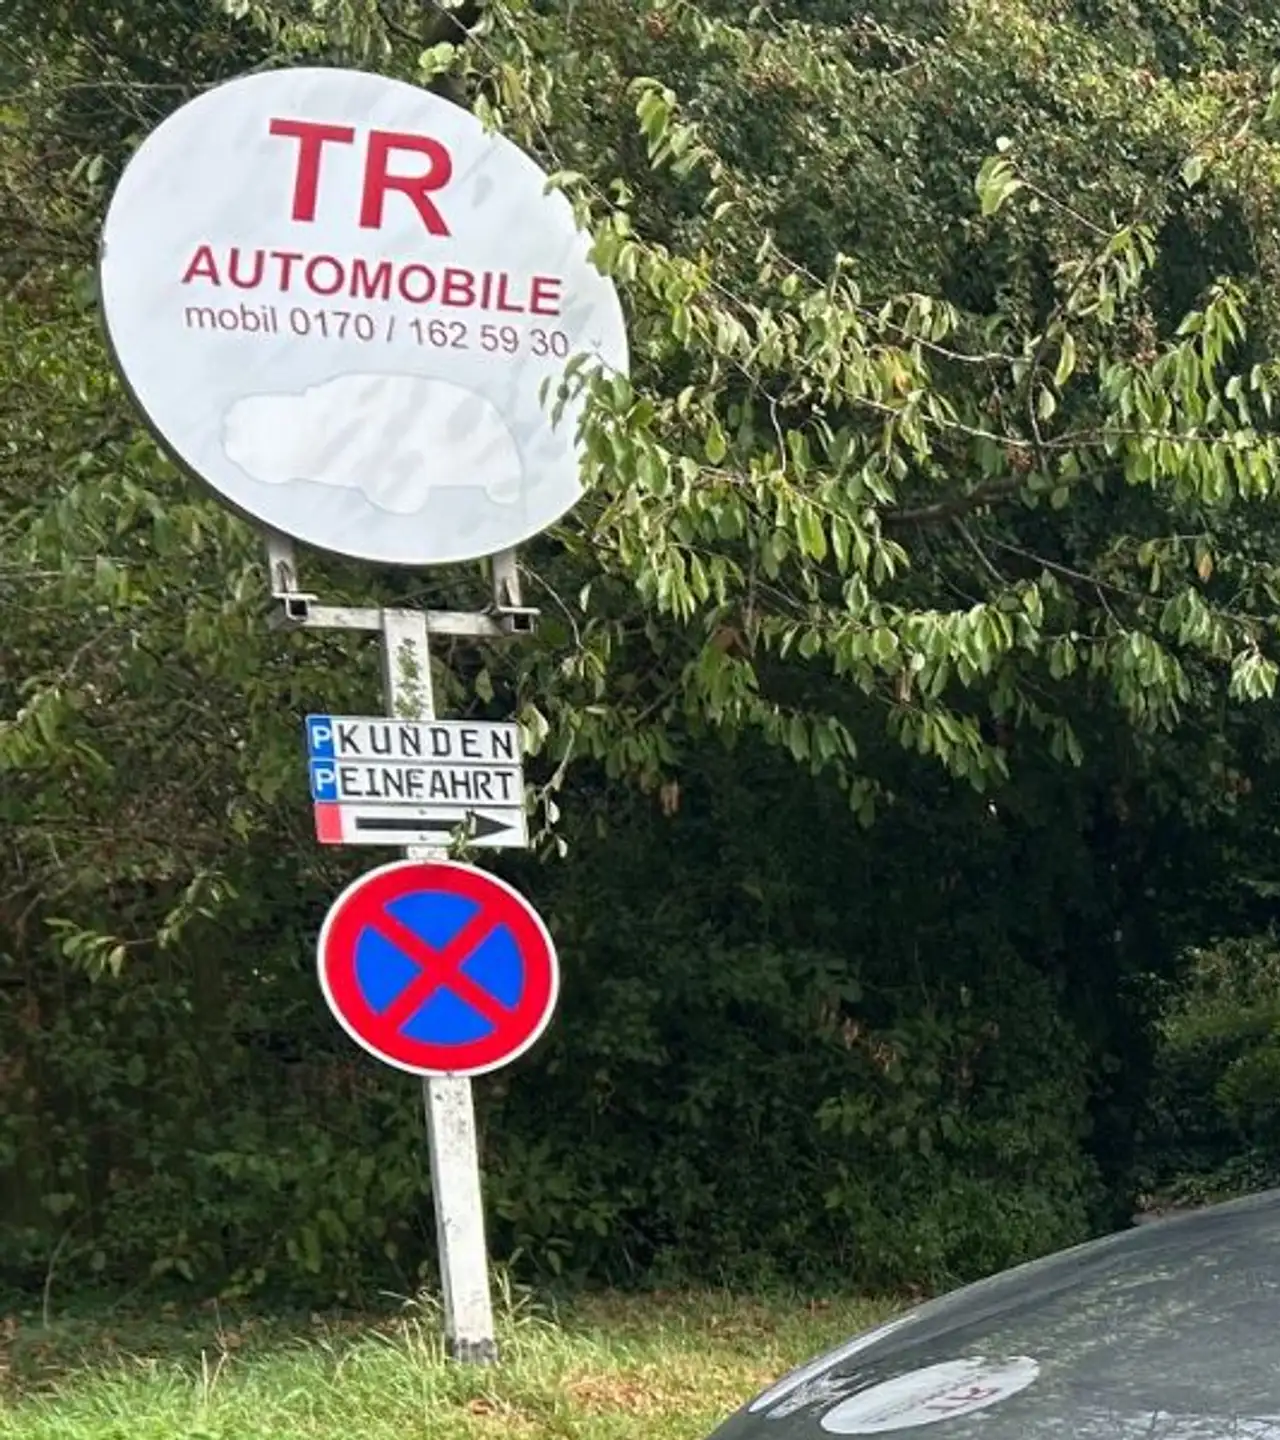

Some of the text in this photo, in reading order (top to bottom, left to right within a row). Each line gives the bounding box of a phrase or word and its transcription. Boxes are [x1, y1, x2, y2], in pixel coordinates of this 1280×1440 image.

[269, 118, 453, 237] TR
[182, 245, 563, 316] AUTOMOBILE
[184, 303, 570, 358] mobil 0170 / 162 59 30
[312, 723, 514, 760] P KUNDEN
[316, 768, 514, 800] P EINFAHRT
